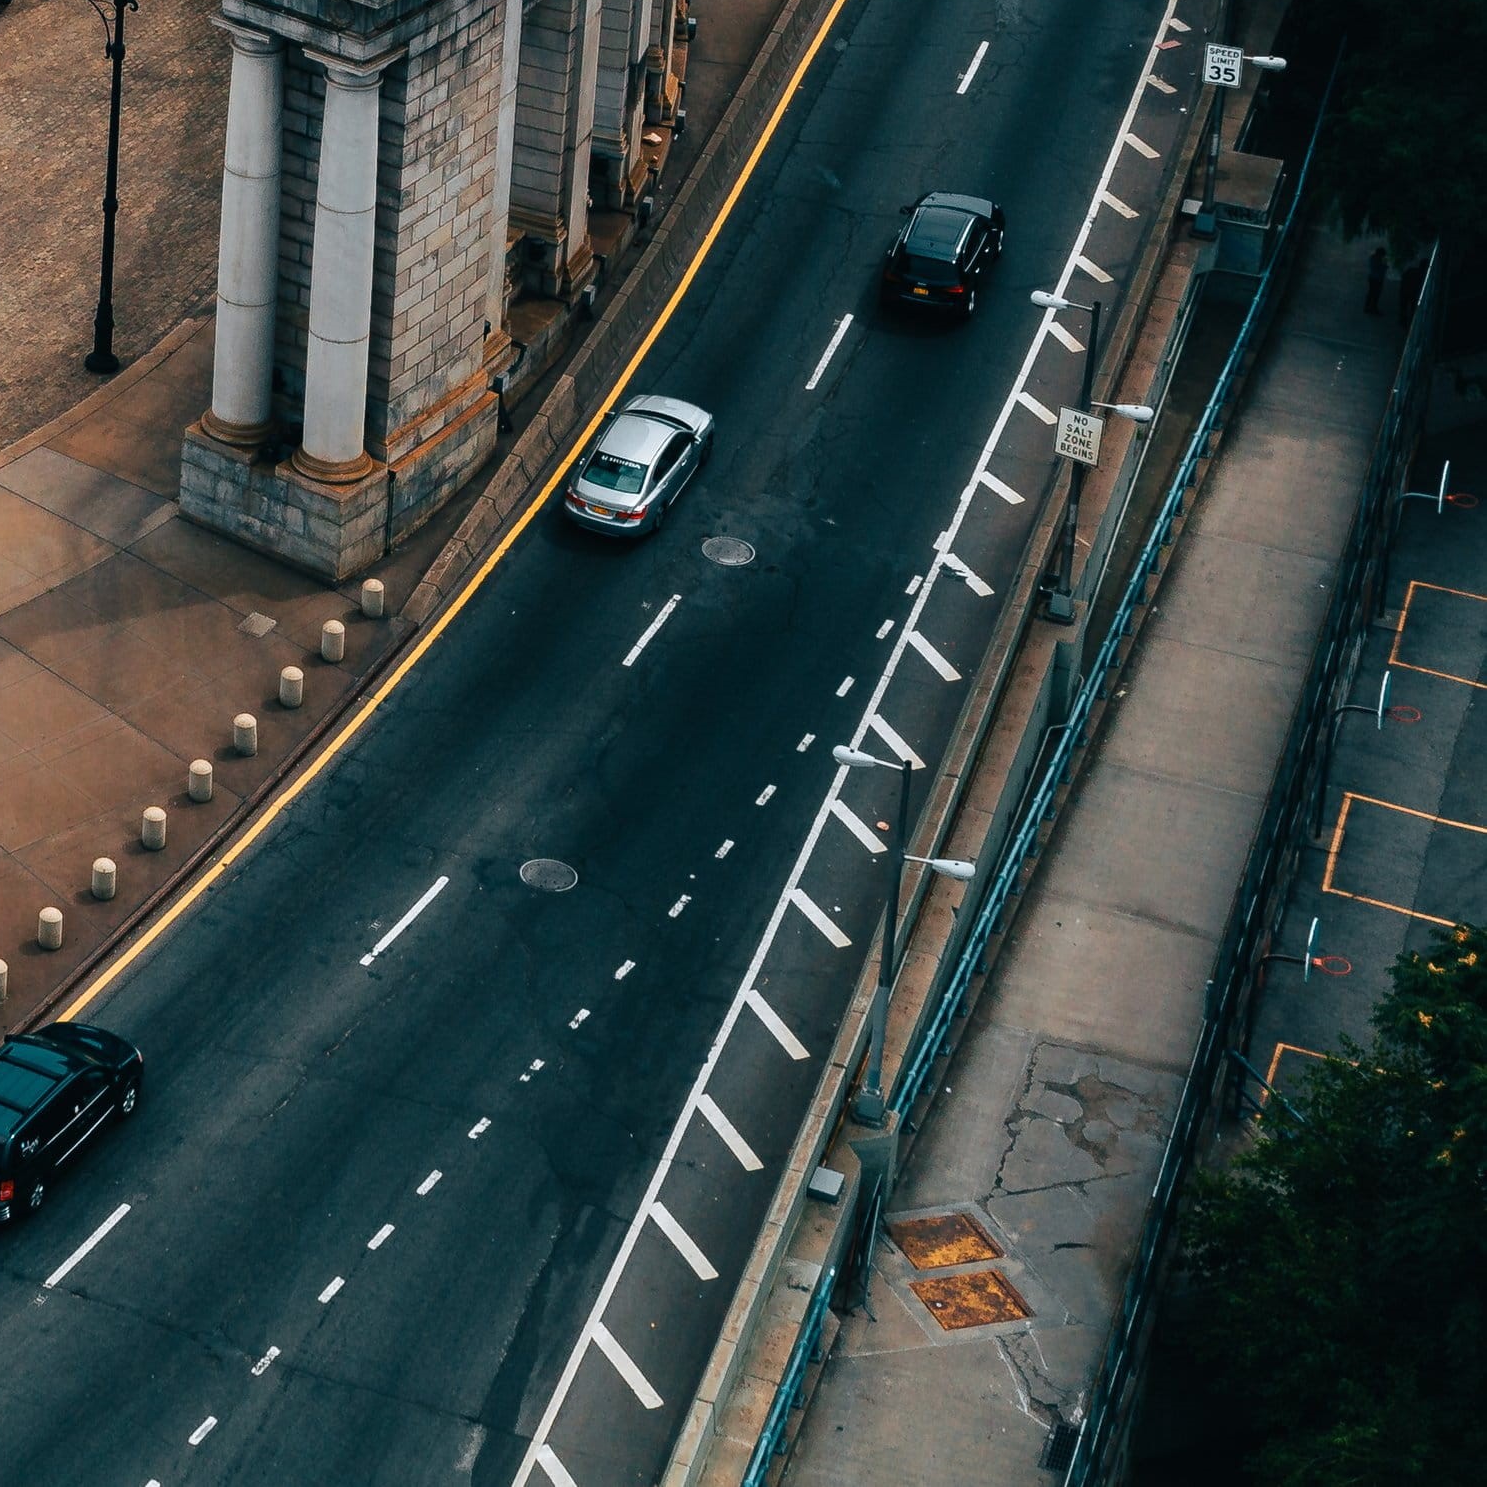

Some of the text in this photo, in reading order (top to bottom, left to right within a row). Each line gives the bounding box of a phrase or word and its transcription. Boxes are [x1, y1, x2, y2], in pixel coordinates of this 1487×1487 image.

[1209, 47, 1239, 59] SPEED
[1211, 57, 1236, 66] LIMIT
[1208, 65, 1236, 83] 35
[1073, 415, 1089, 426] NO
[1066, 423, 1093, 440] SALT
[1063, 432, 1093, 450] ZONE
[1060, 442, 1094, 461] BEGINS
